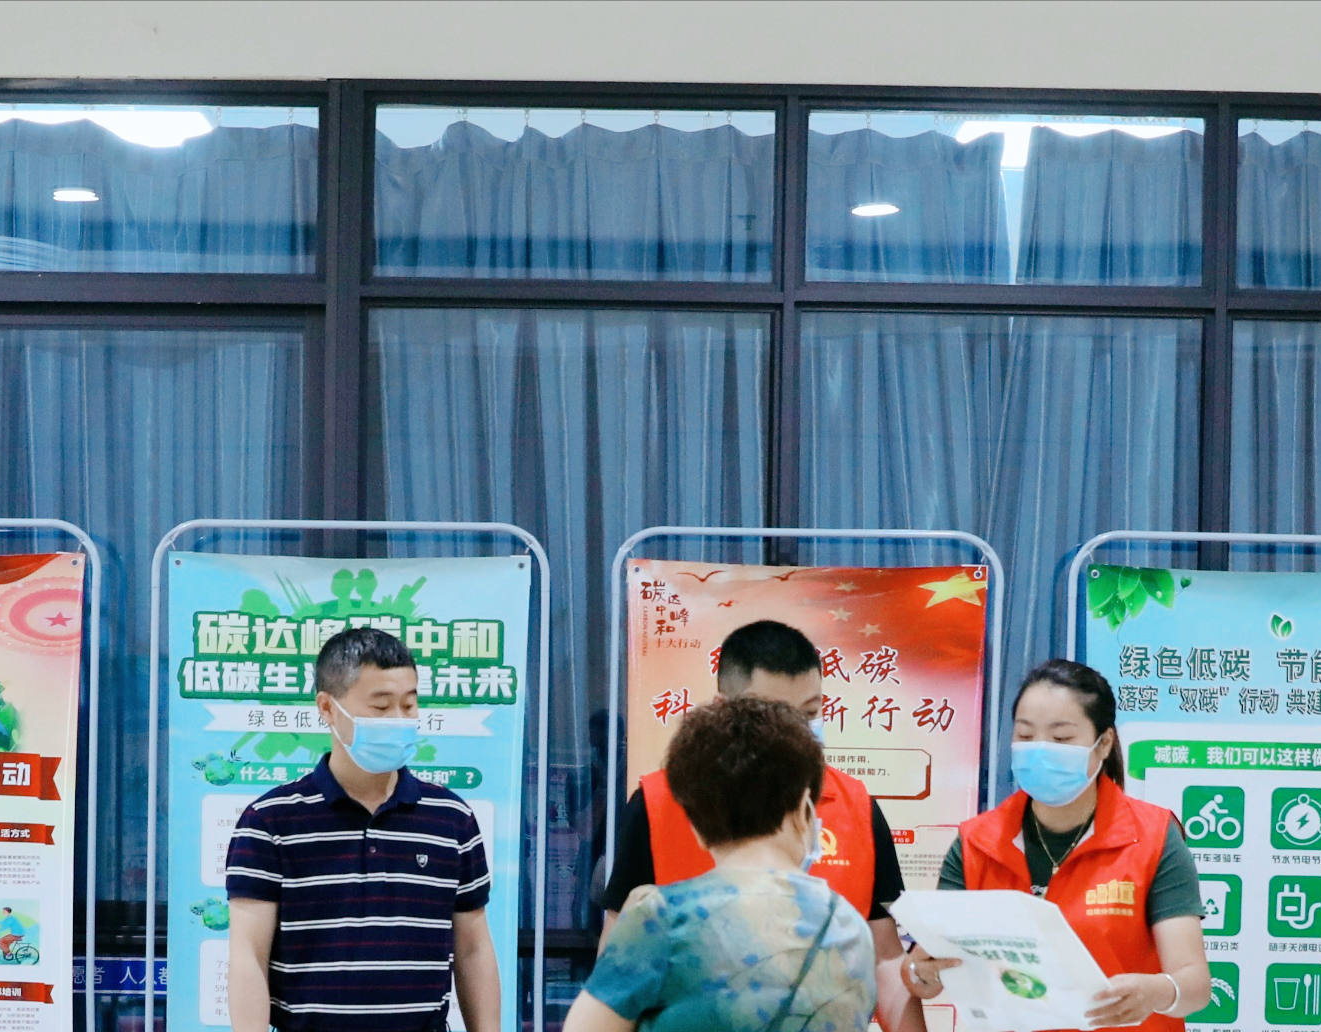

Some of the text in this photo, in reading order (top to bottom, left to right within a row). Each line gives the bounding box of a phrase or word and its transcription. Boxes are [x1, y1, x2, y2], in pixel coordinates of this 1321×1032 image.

[1119, 645, 1252, 681] 绿色低碳
[240, 766, 288, 781] 什么是
